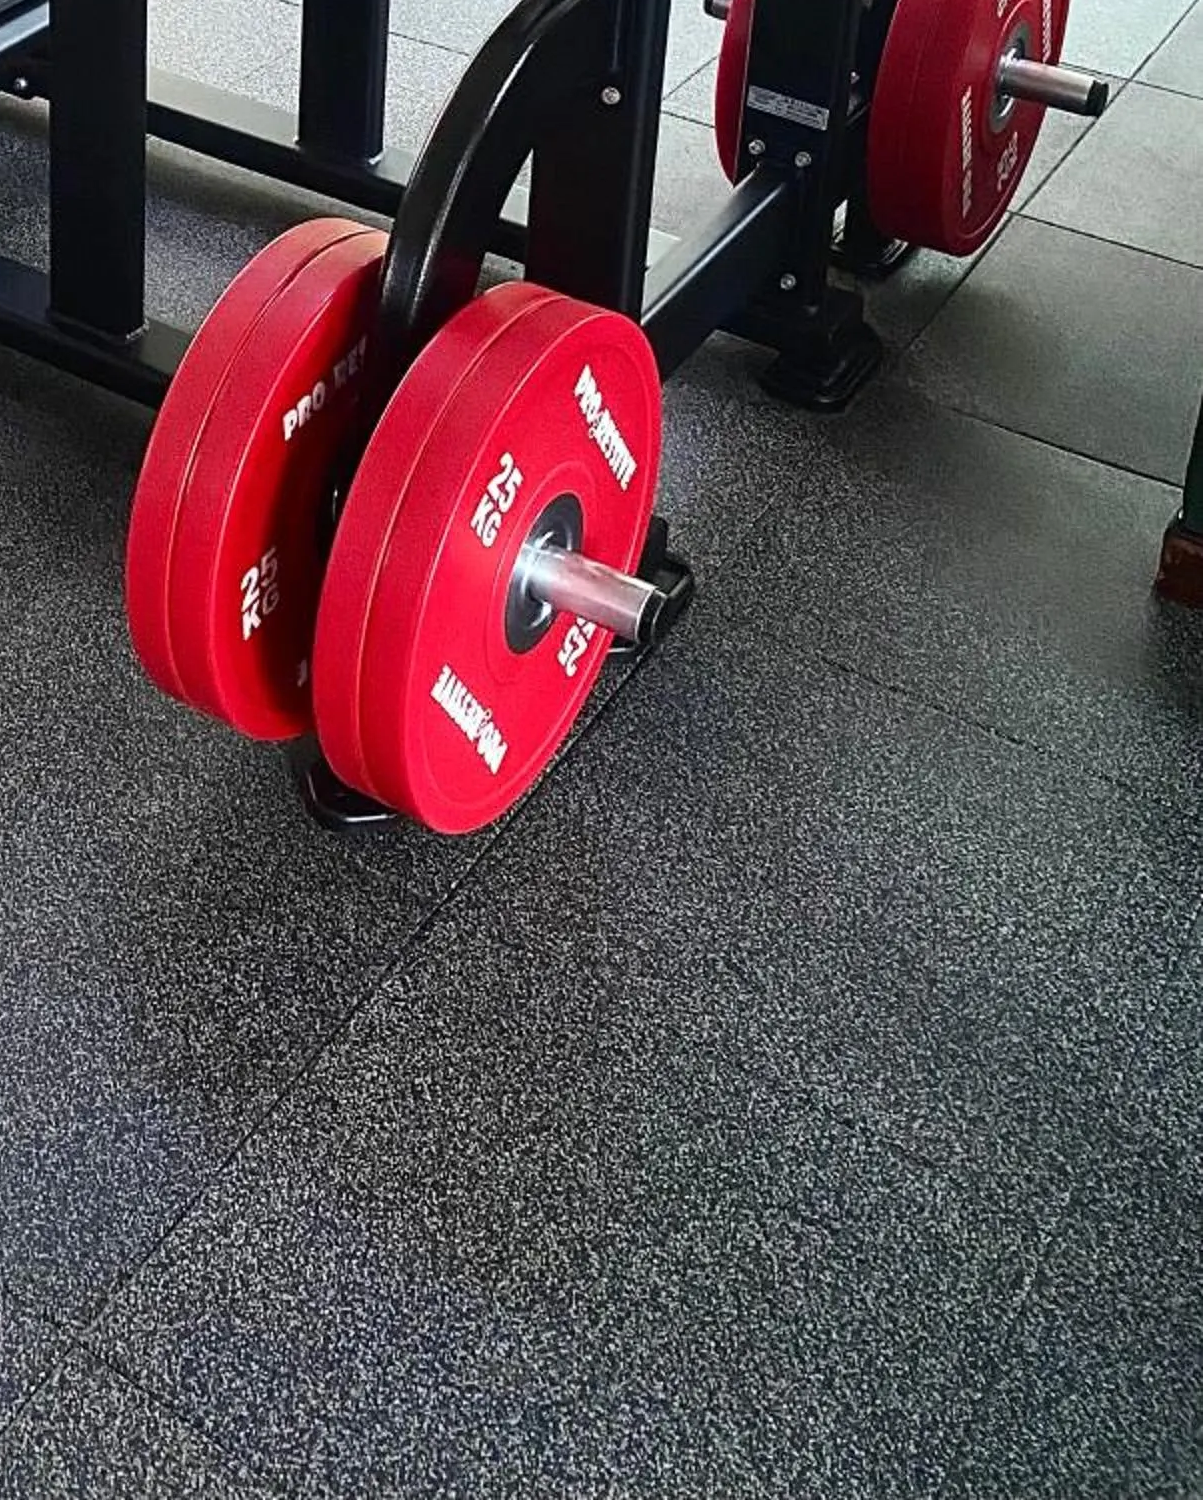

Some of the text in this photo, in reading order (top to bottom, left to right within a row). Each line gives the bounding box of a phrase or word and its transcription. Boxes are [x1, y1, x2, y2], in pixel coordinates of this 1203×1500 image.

[282, 382, 326, 442] PRO
[486, 452, 524, 513] 25
[470, 493, 502, 548] KG
[240, 547, 278, 613] 25
[242, 583, 280, 641] KG
[557, 625, 588, 677] 25
